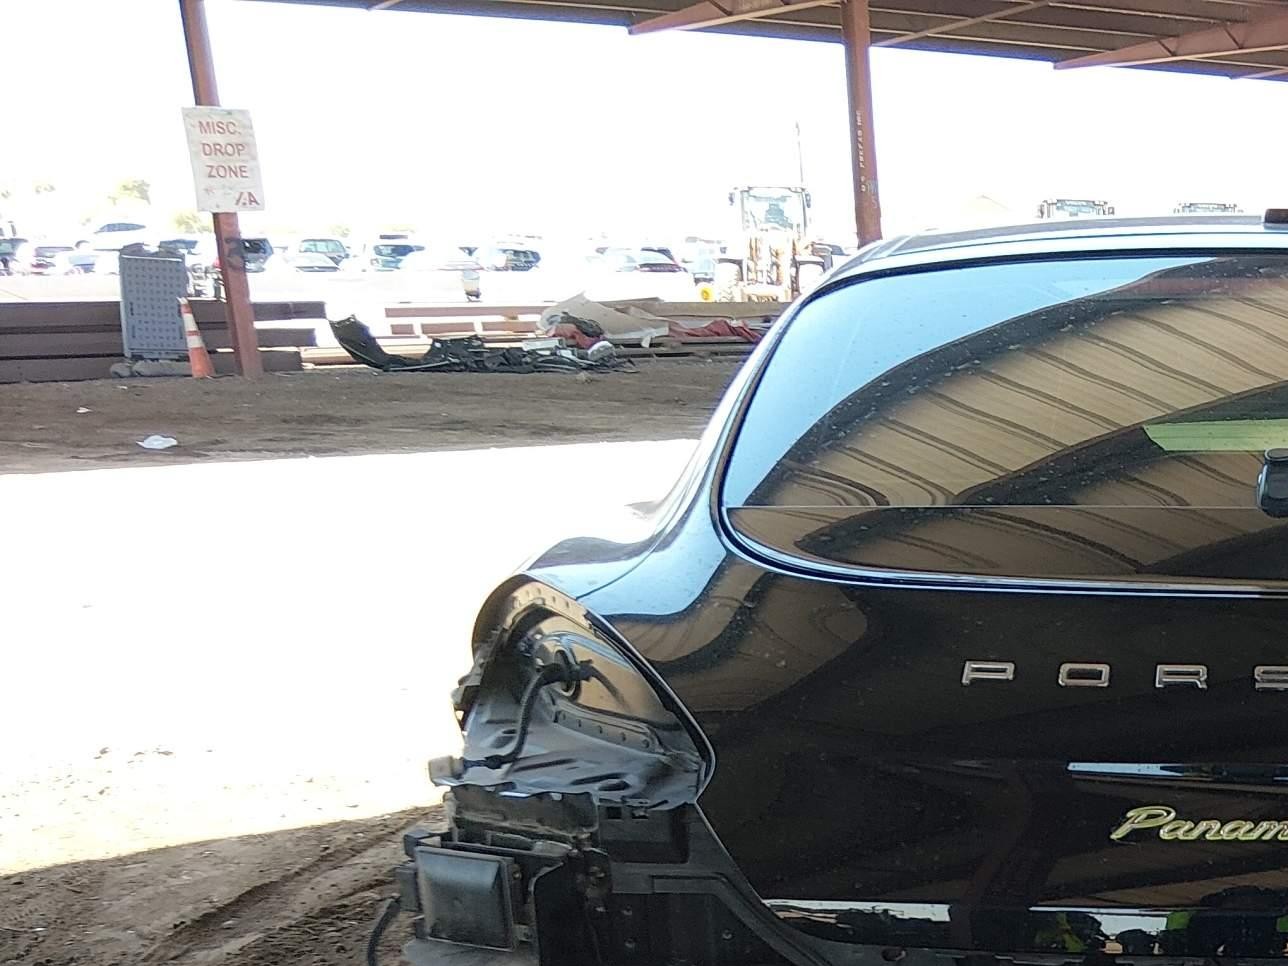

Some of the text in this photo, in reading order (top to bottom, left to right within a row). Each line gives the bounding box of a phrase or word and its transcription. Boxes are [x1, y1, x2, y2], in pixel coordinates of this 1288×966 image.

[198, 120, 242, 135] MISC.
[201, 142, 246, 157] DROP
[206, 165, 249, 178] ZONE
